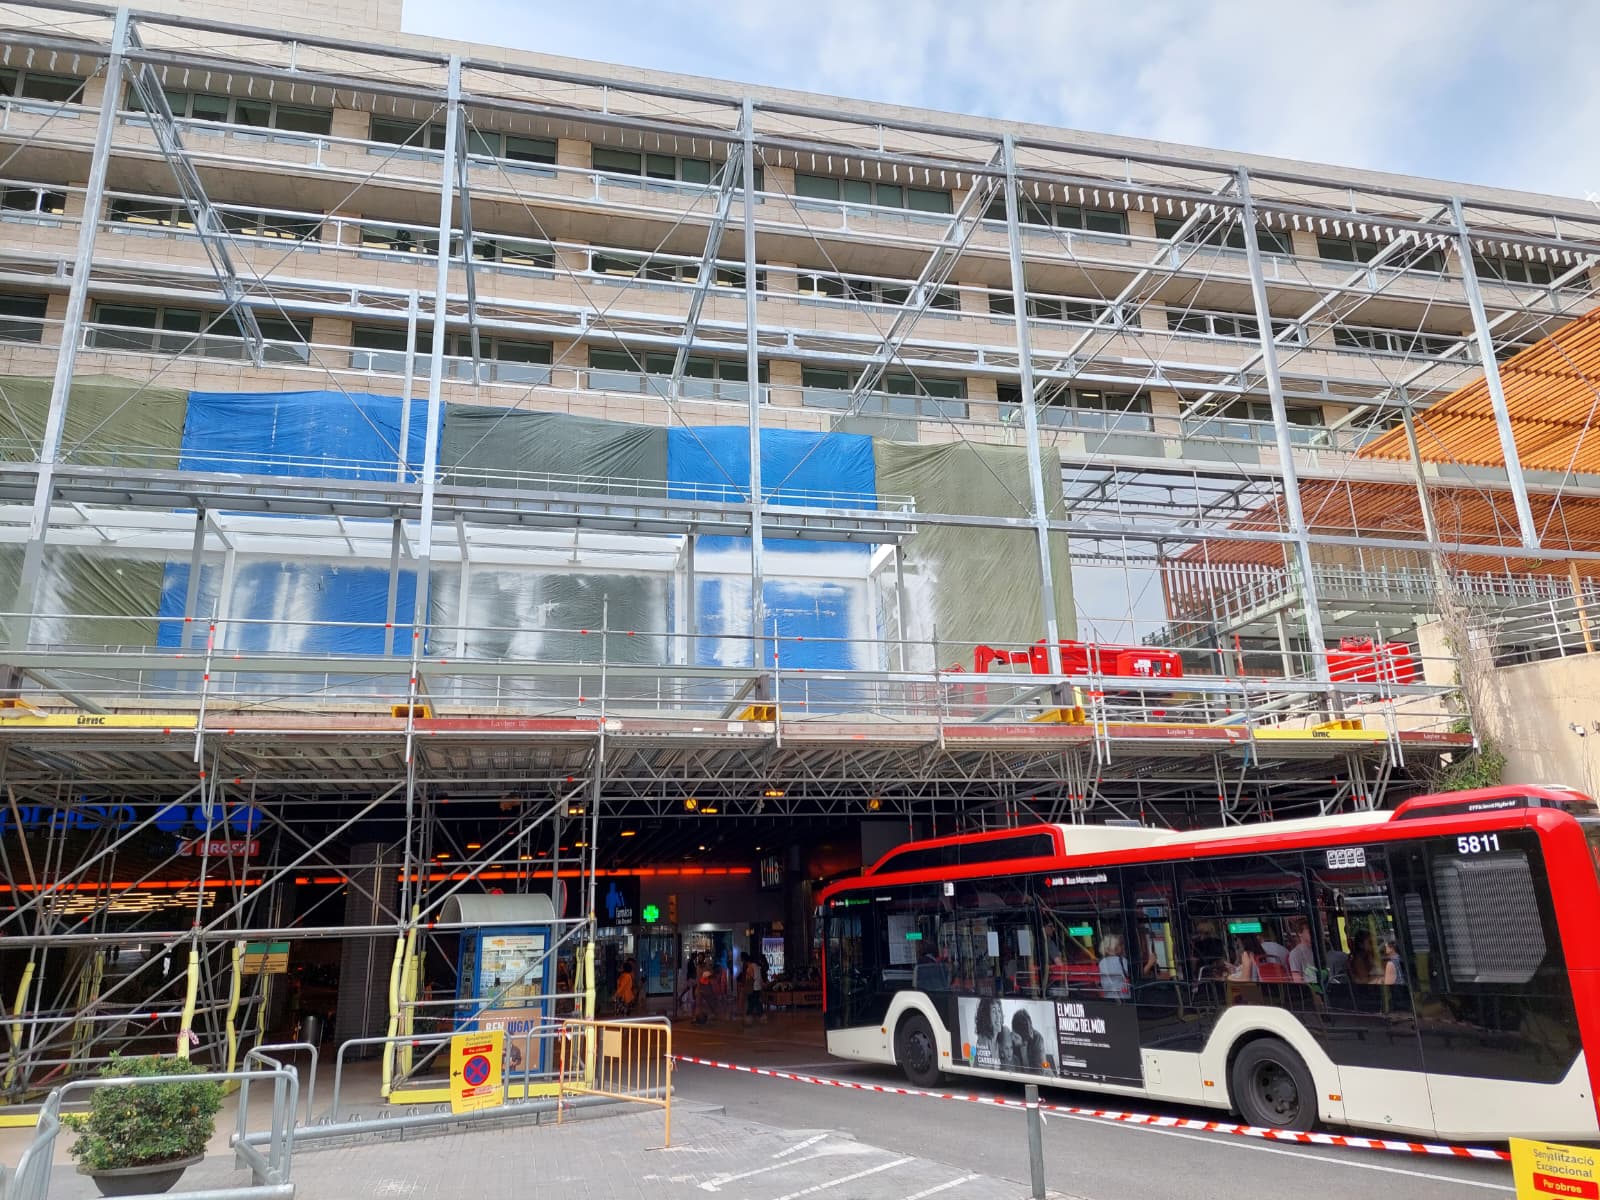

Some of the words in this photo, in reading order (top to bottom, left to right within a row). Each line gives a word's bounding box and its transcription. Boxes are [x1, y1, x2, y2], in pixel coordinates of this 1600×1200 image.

[1457, 834, 1500, 854] 5811
[1057, 1002, 1065, 1017] EL
[1533, 1149, 1594, 1166] Senyalització
[1543, 1178, 1554, 1189] Per
[1554, 1182, 1582, 1193] obres
